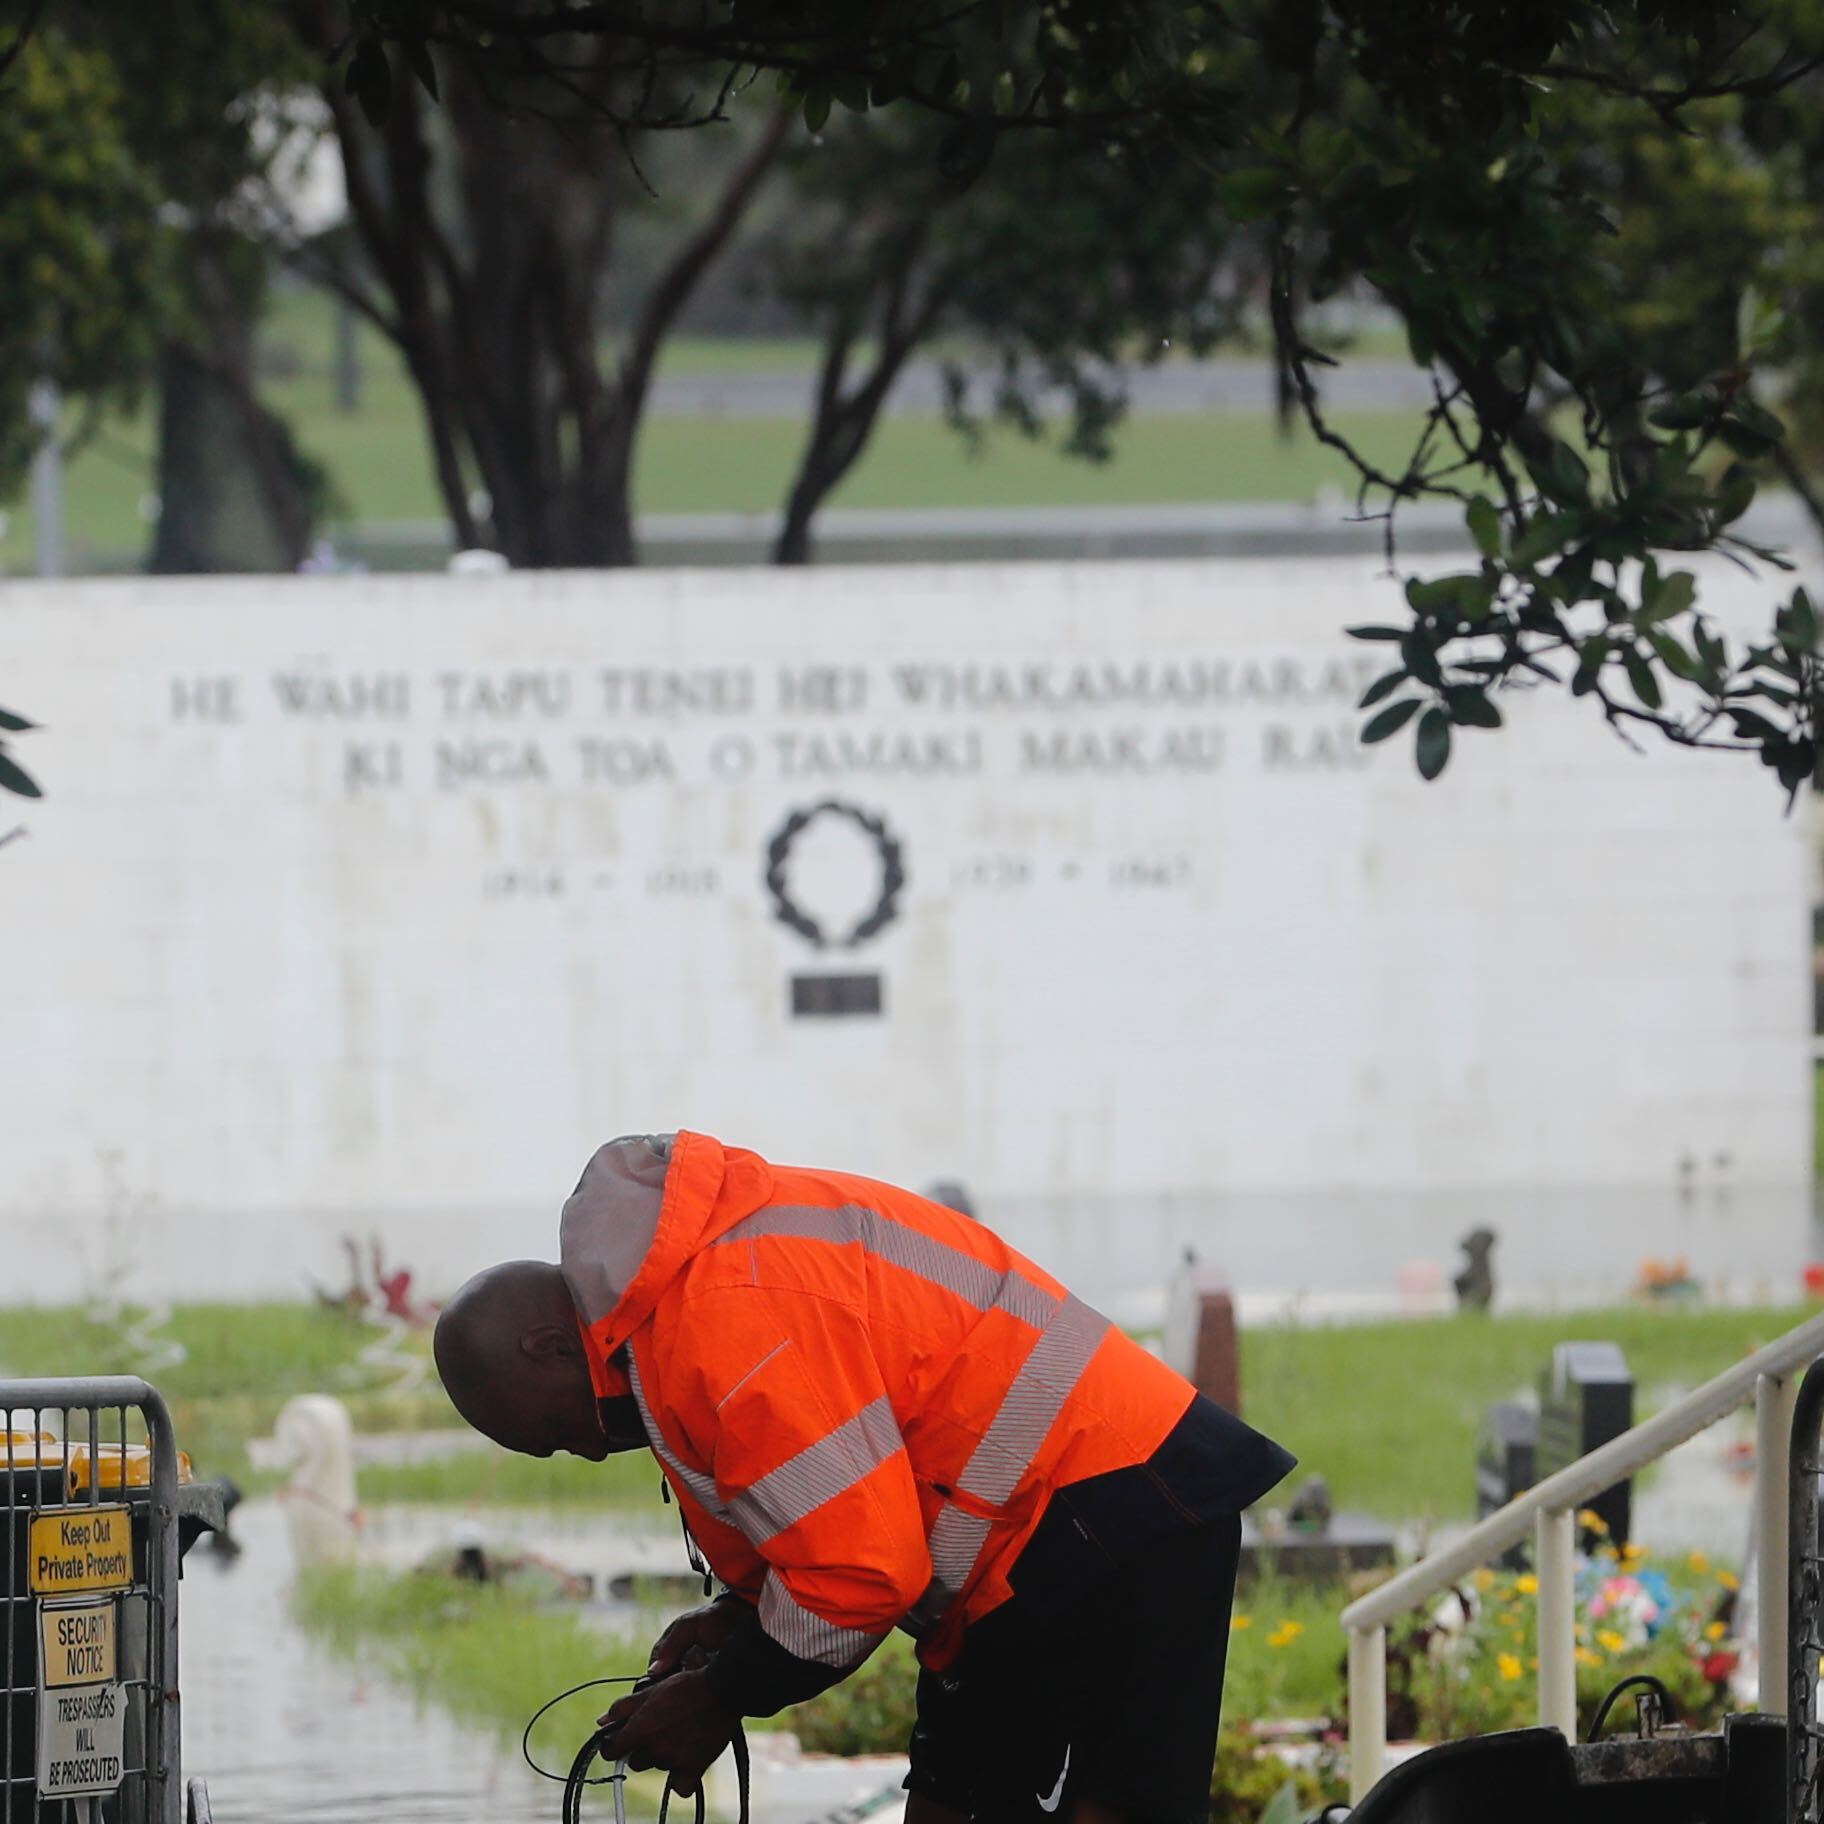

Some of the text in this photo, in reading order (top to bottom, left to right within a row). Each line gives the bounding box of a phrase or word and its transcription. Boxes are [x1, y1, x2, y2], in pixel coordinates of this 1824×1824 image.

[169, 676, 243, 724] HE
[436, 670, 574, 719] TAPU
[601, 667, 756, 716] TENEI
[777, 666, 869, 712] HEI
[344, 741, 404, 791] KI
[578, 738, 674, 785] TOA
[708, 736, 758, 784] O
[774, 732, 982, 776] TAMAKI
[1020, 729, 1227, 772] MAKAU
[61, 1518, 111, 1550] Keep Out
[38, 1550, 127, 1580] Private Property
[67, 1645, 104, 1676] NOTICE
[58, 1694, 115, 1723] TRESPASSERS
[76, 1727, 95, 1752] WILL
[49, 1756, 120, 1786] BE PROSECUTED
